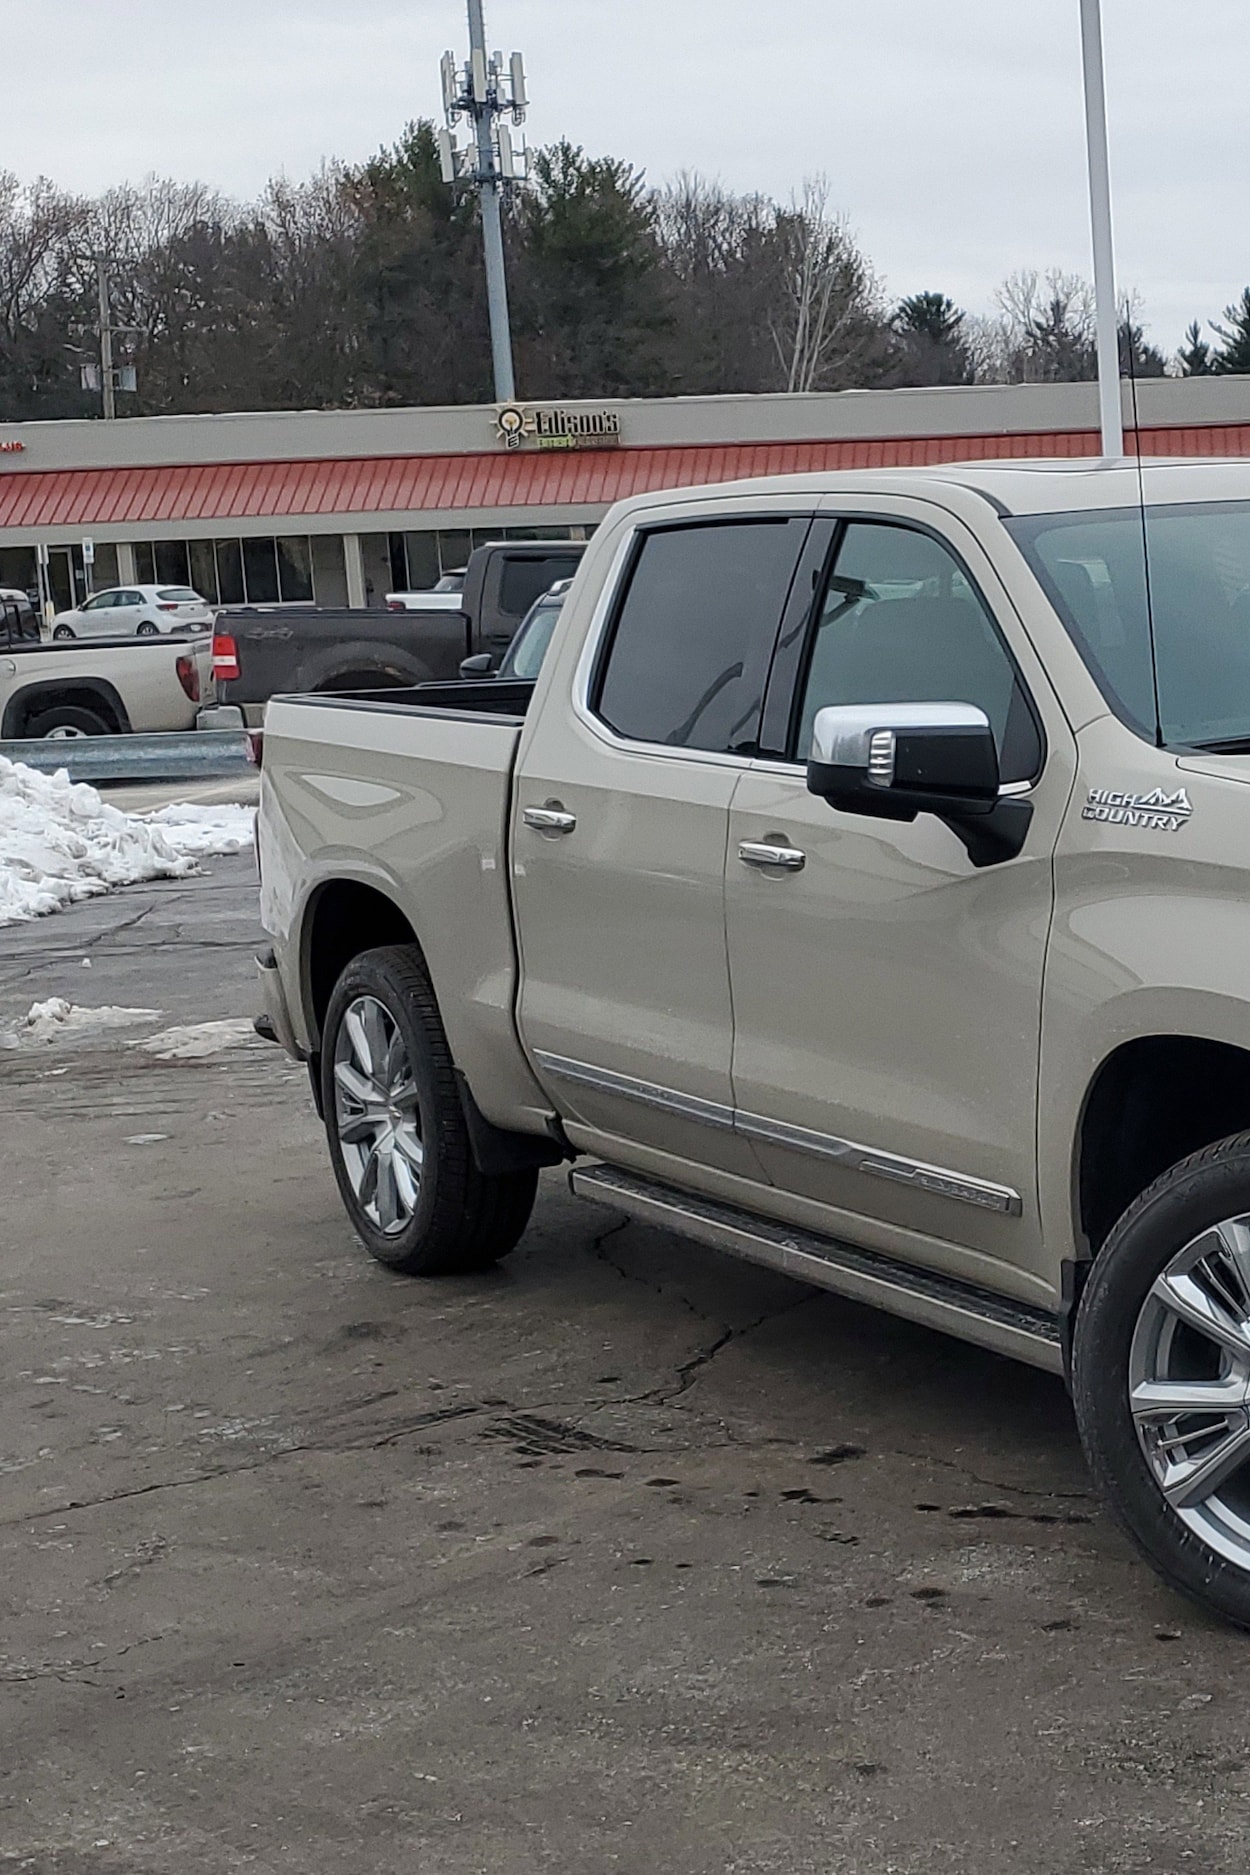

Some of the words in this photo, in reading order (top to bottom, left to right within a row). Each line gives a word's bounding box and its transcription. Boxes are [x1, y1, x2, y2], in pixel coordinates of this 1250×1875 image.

[535, 410, 620, 434] Edison's
[1087, 788, 1139, 807] HIGH
[1082, 806, 1189, 832] COUNTRY
